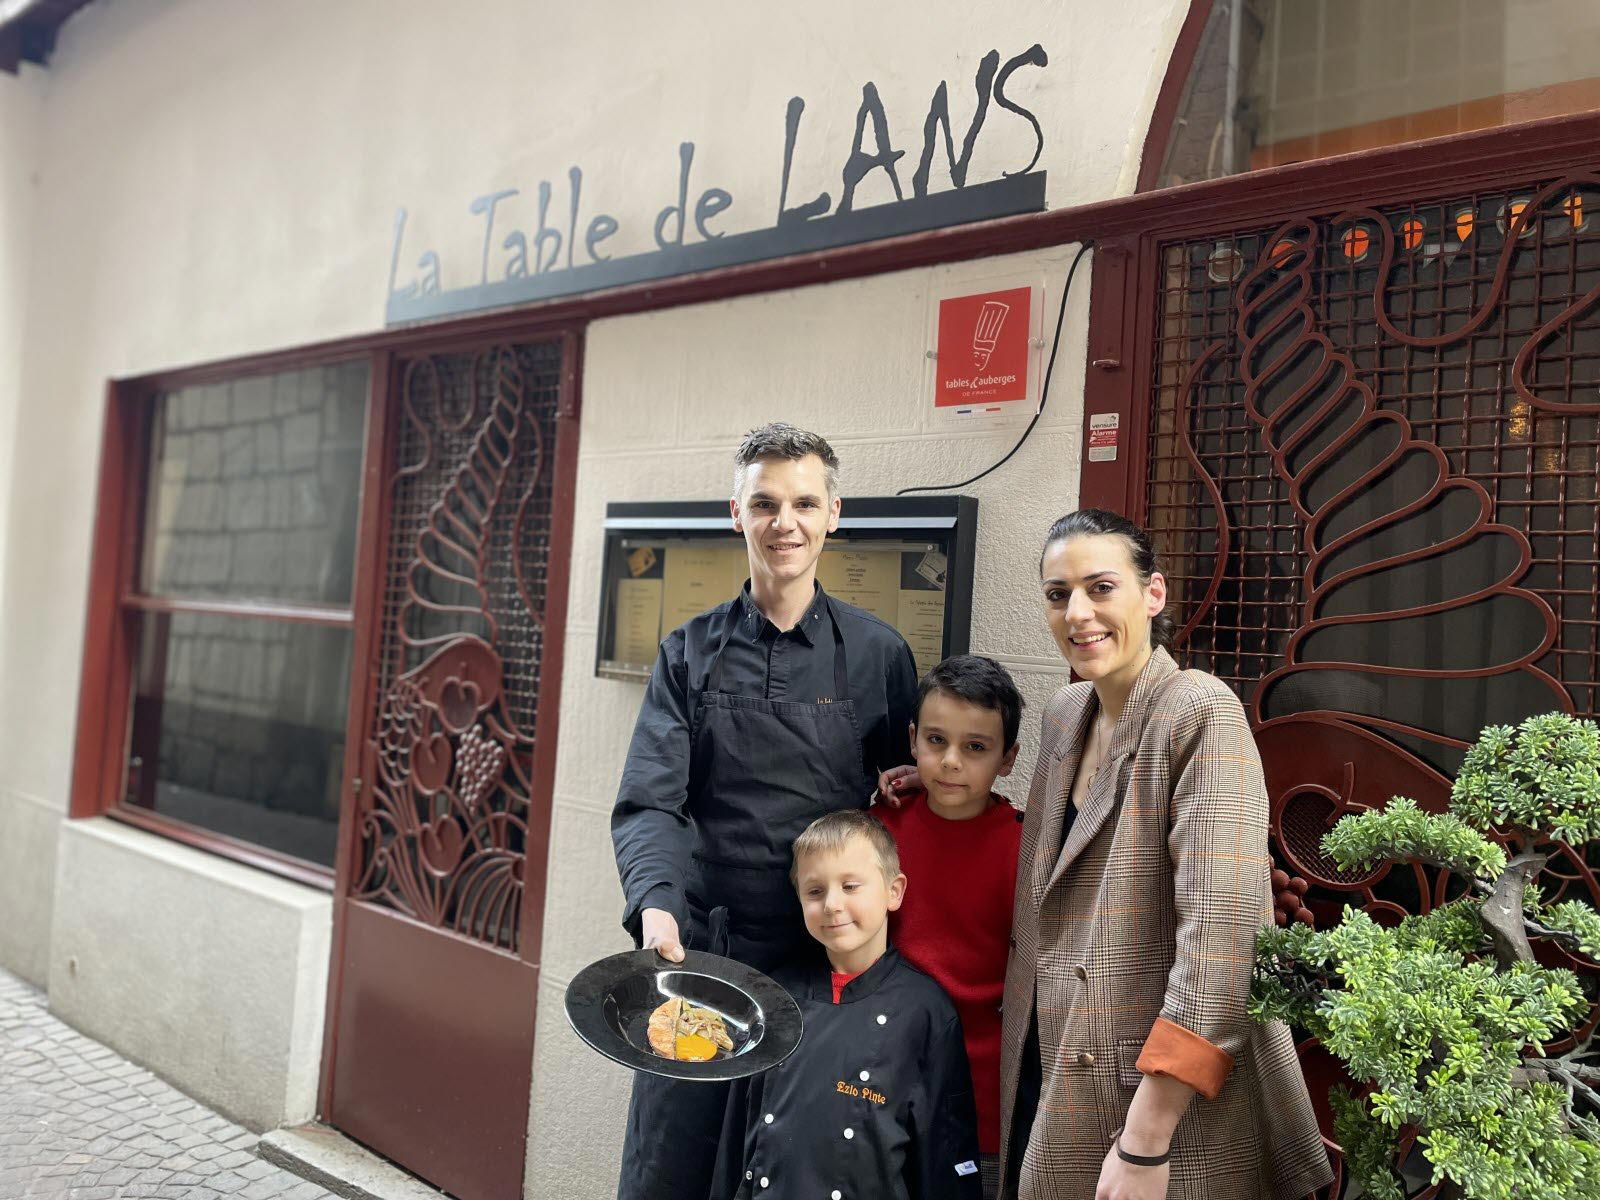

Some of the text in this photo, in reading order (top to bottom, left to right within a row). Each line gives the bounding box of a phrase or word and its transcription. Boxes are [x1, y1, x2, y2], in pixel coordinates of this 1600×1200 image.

[386, 43, 1049, 300] La Table de LANS
[945, 379, 970, 389] tables
[979, 374, 1016, 386] auberges
